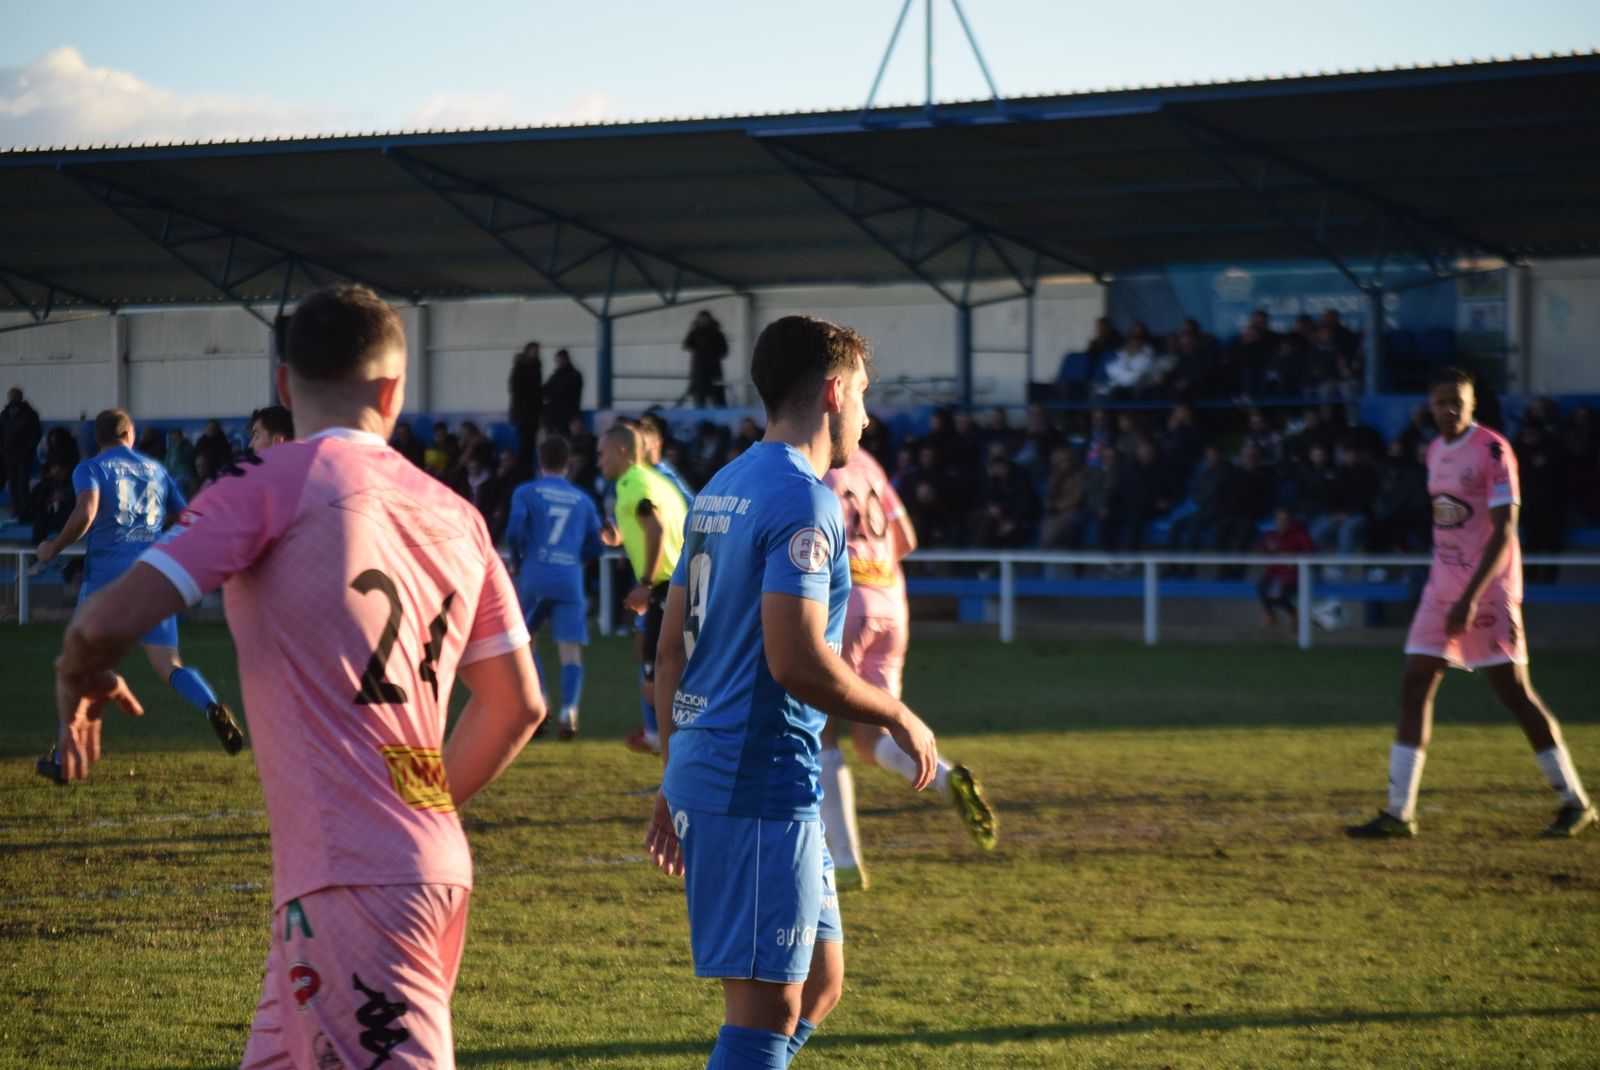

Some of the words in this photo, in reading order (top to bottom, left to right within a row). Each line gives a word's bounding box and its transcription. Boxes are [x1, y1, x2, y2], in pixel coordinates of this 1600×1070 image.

[115, 479, 161, 527] 14
[548, 506, 571, 545] 7
[683, 553, 712, 661] 9
